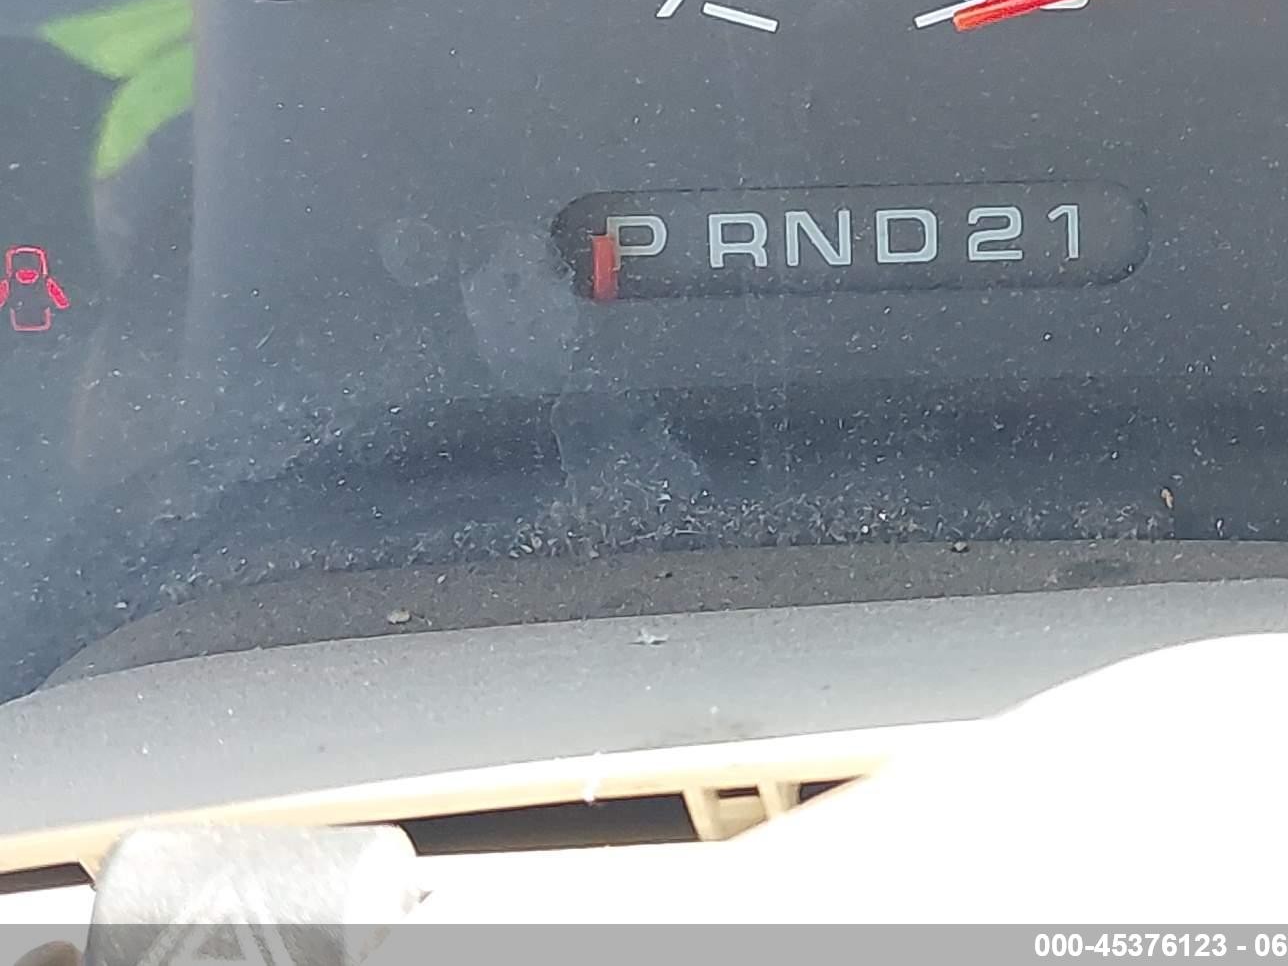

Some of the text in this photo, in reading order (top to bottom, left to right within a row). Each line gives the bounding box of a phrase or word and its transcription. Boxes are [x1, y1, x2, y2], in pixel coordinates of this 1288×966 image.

[606, 215, 668, 272] P
[875, 209, 939, 263] D
[967, 205, 1024, 261] 2
[1047, 204, 1080, 259] 1
